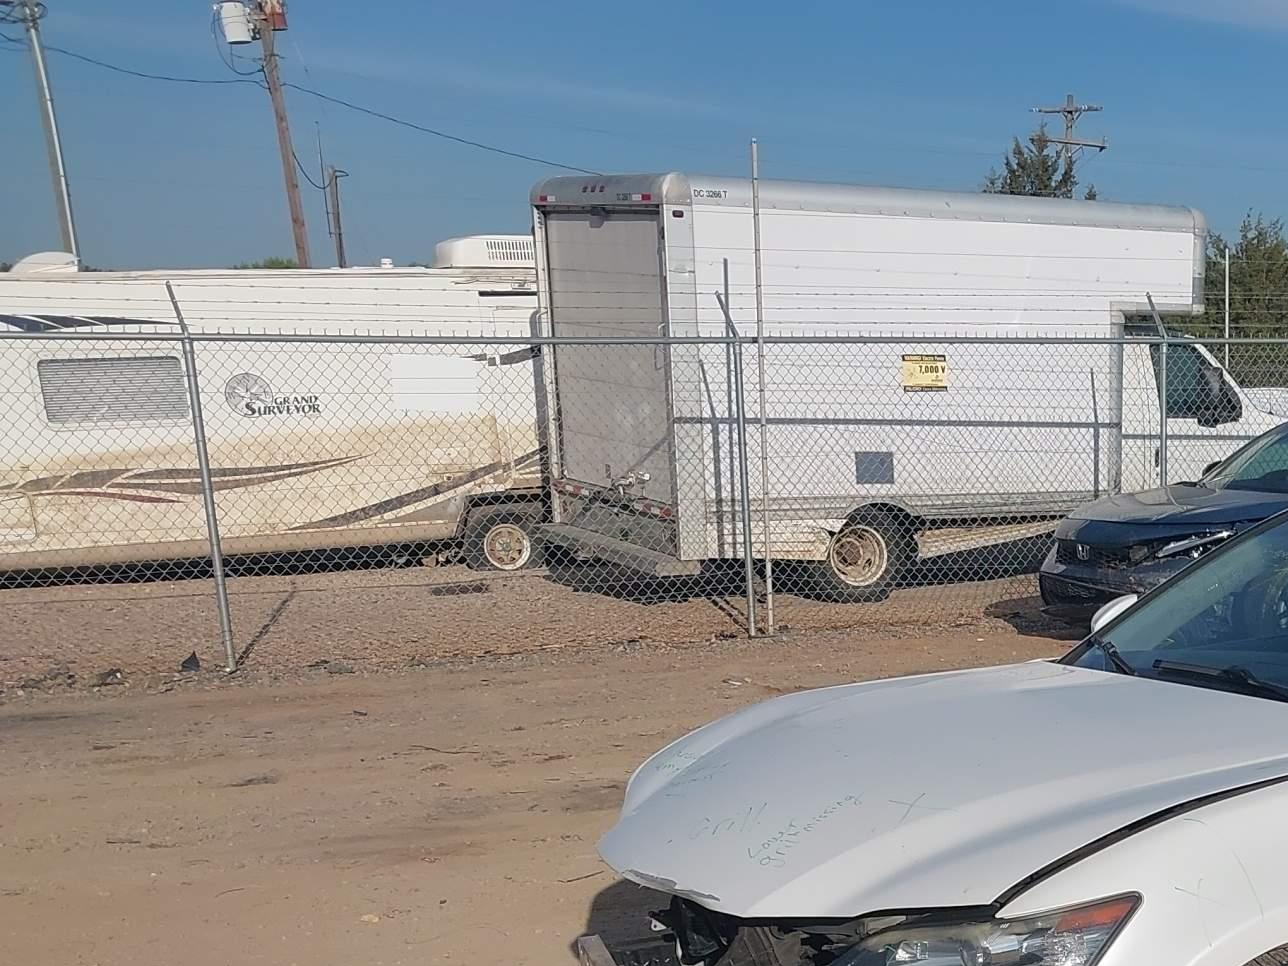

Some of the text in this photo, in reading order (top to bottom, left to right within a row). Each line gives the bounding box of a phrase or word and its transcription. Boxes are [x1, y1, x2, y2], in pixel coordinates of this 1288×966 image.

[693, 188, 704, 198] DC
[722, 189, 728, 199] T
[918, 364, 939, 375] 7,000
[274, 394, 319, 406] GRAND
[244, 401, 321, 417] SURVEYOR
